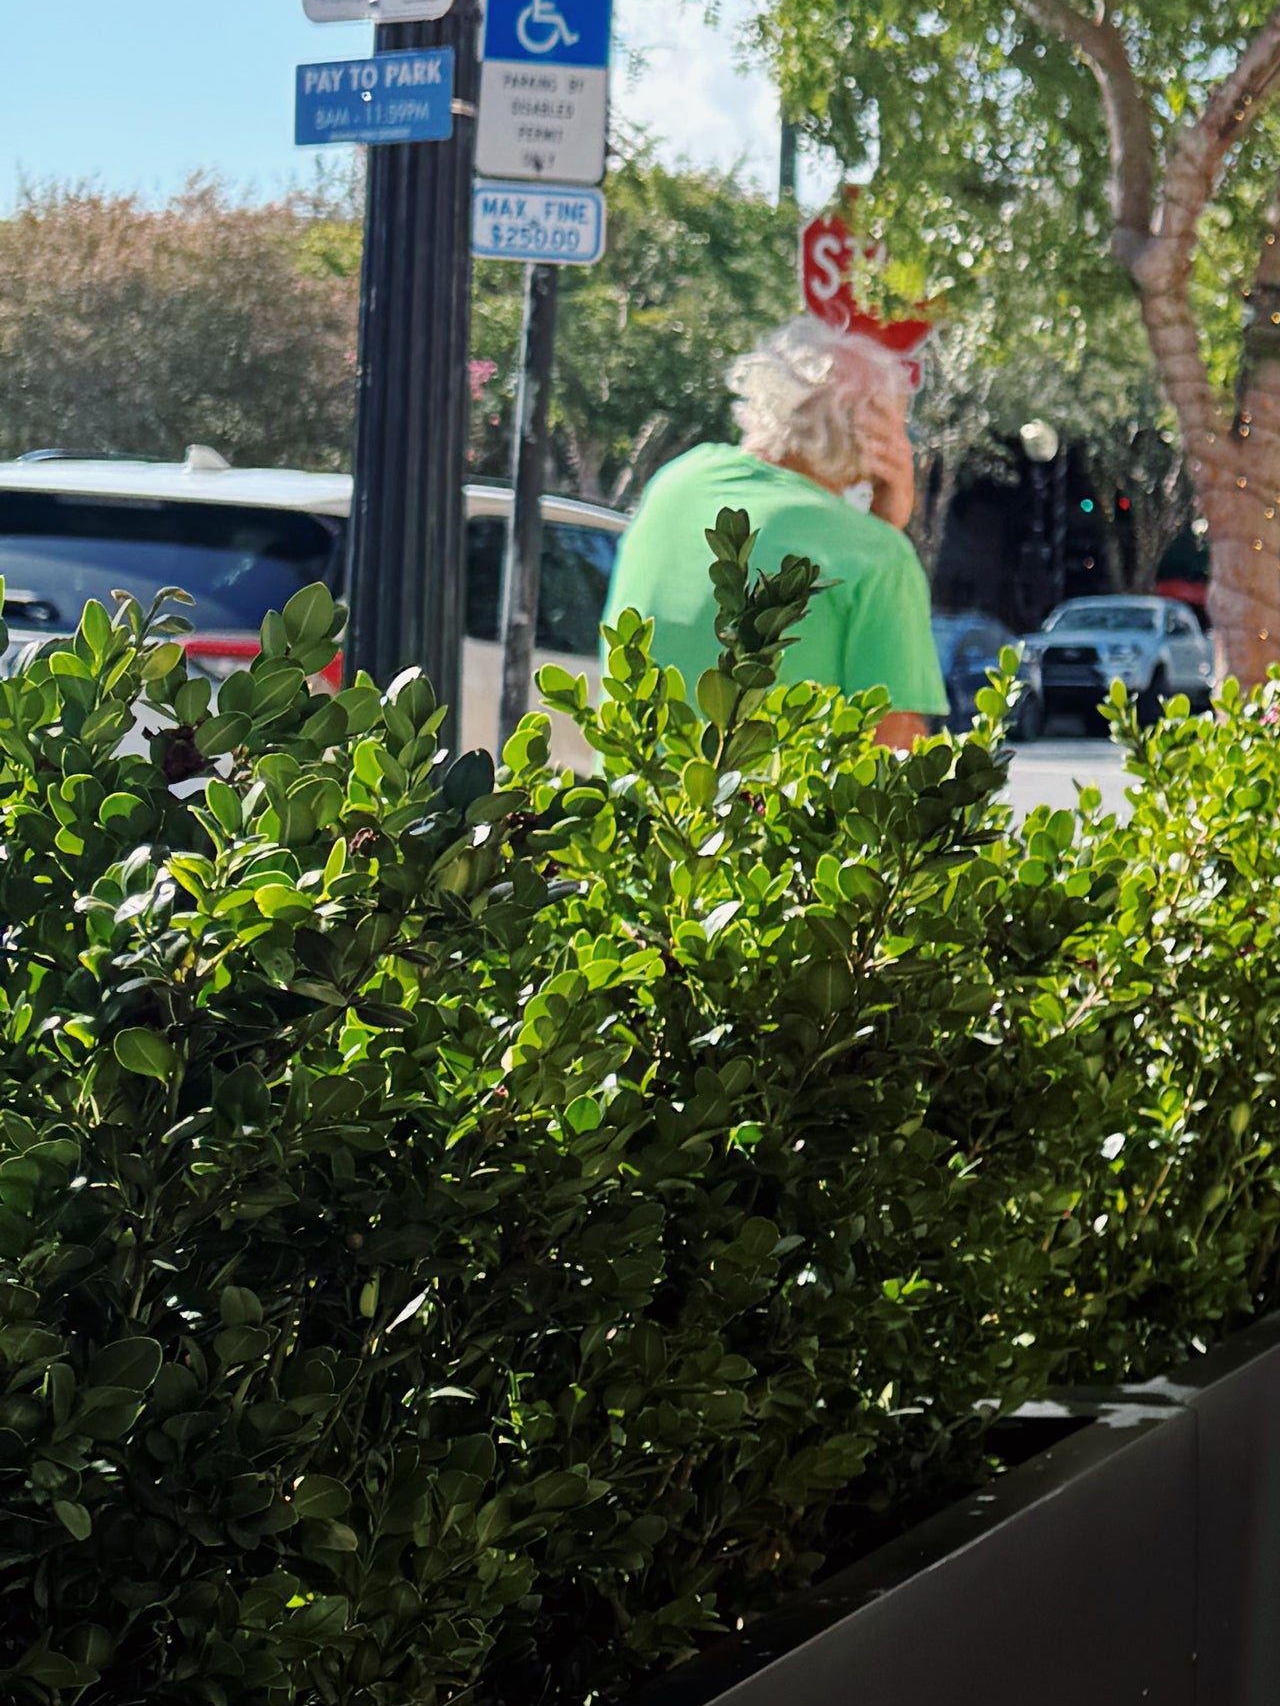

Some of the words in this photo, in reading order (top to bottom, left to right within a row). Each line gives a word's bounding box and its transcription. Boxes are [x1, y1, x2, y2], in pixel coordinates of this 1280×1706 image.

[304, 68, 344, 94] PAY
[349, 63, 378, 92] TO
[384, 57, 442, 89] PARK
[511, 97, 574, 119] DISABLED
[517, 124, 564, 144] PERMIT
[482, 197, 527, 218] MAX
[544, 201, 587, 224] FINE
